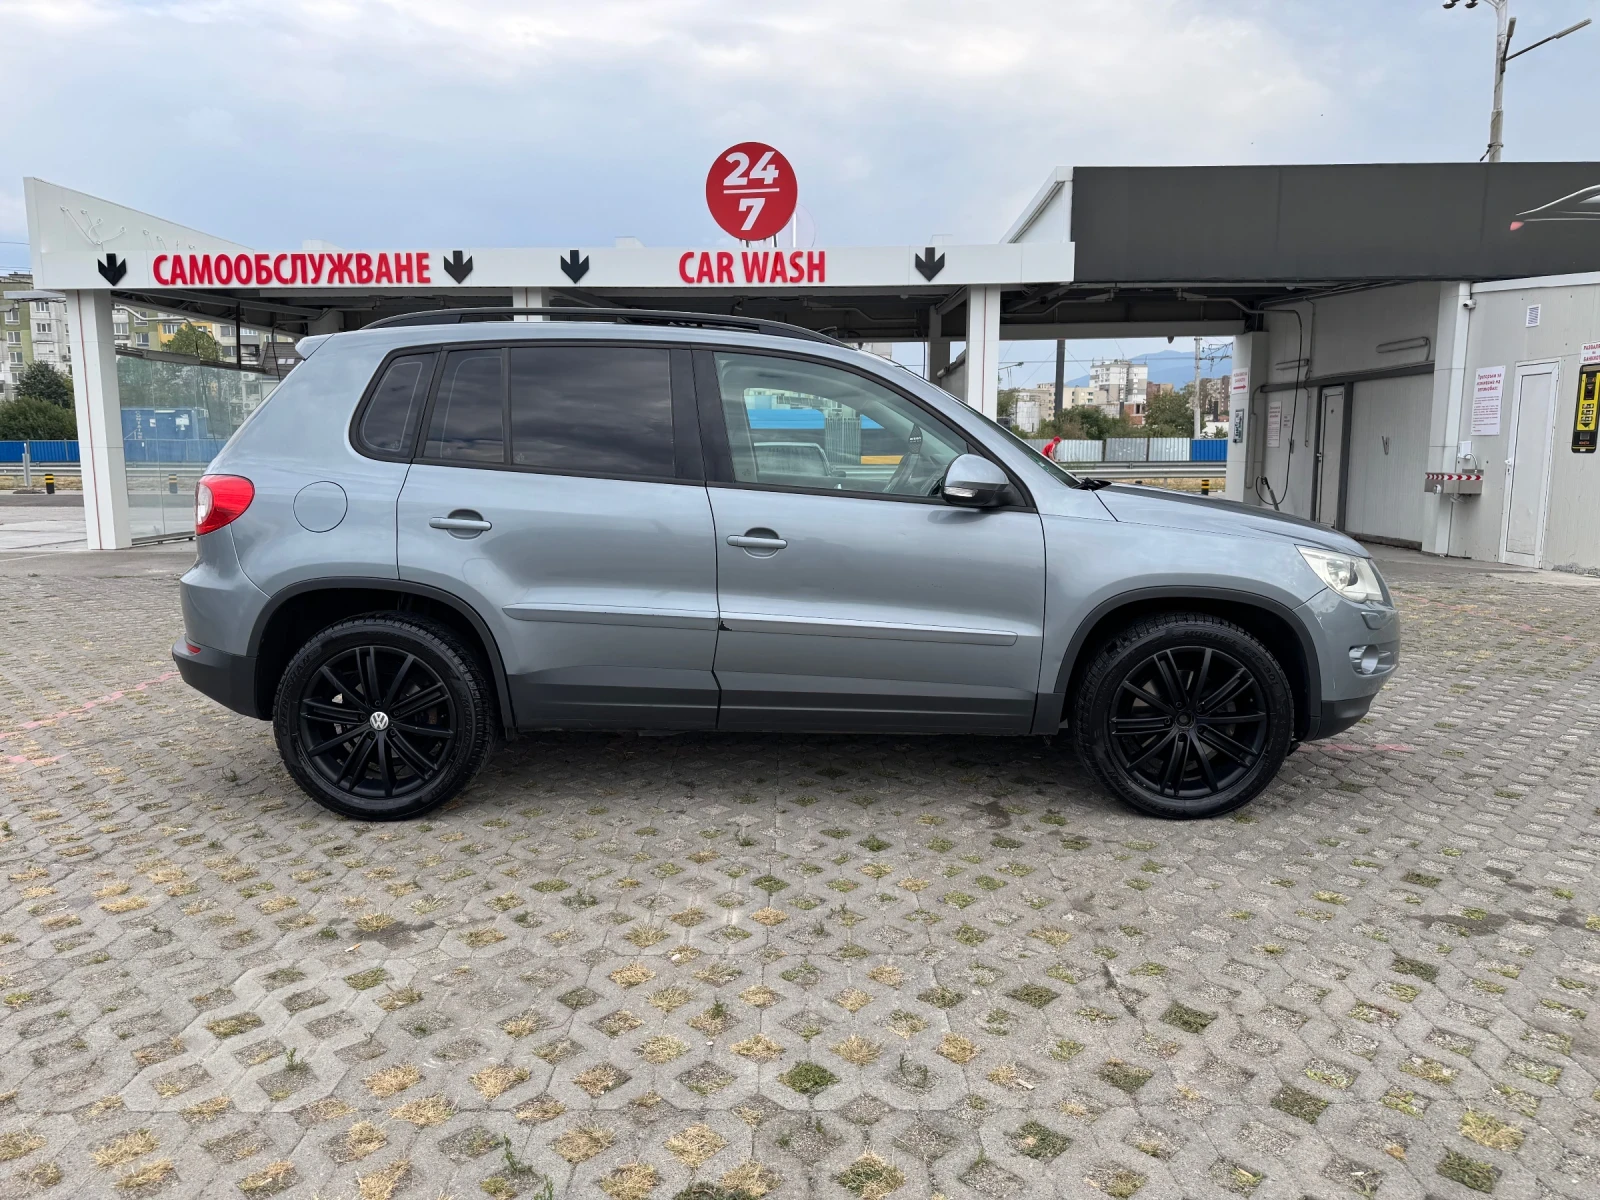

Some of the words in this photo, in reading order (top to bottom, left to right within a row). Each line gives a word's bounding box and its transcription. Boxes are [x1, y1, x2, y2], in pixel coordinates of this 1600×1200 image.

[723, 151, 779, 186] 24
[738, 198, 766, 231] 7
[152, 252, 431, 286] САМООБСЛУЖВАНЕ
[679, 251, 735, 284] CAR
[741, 251, 826, 283] WASH
